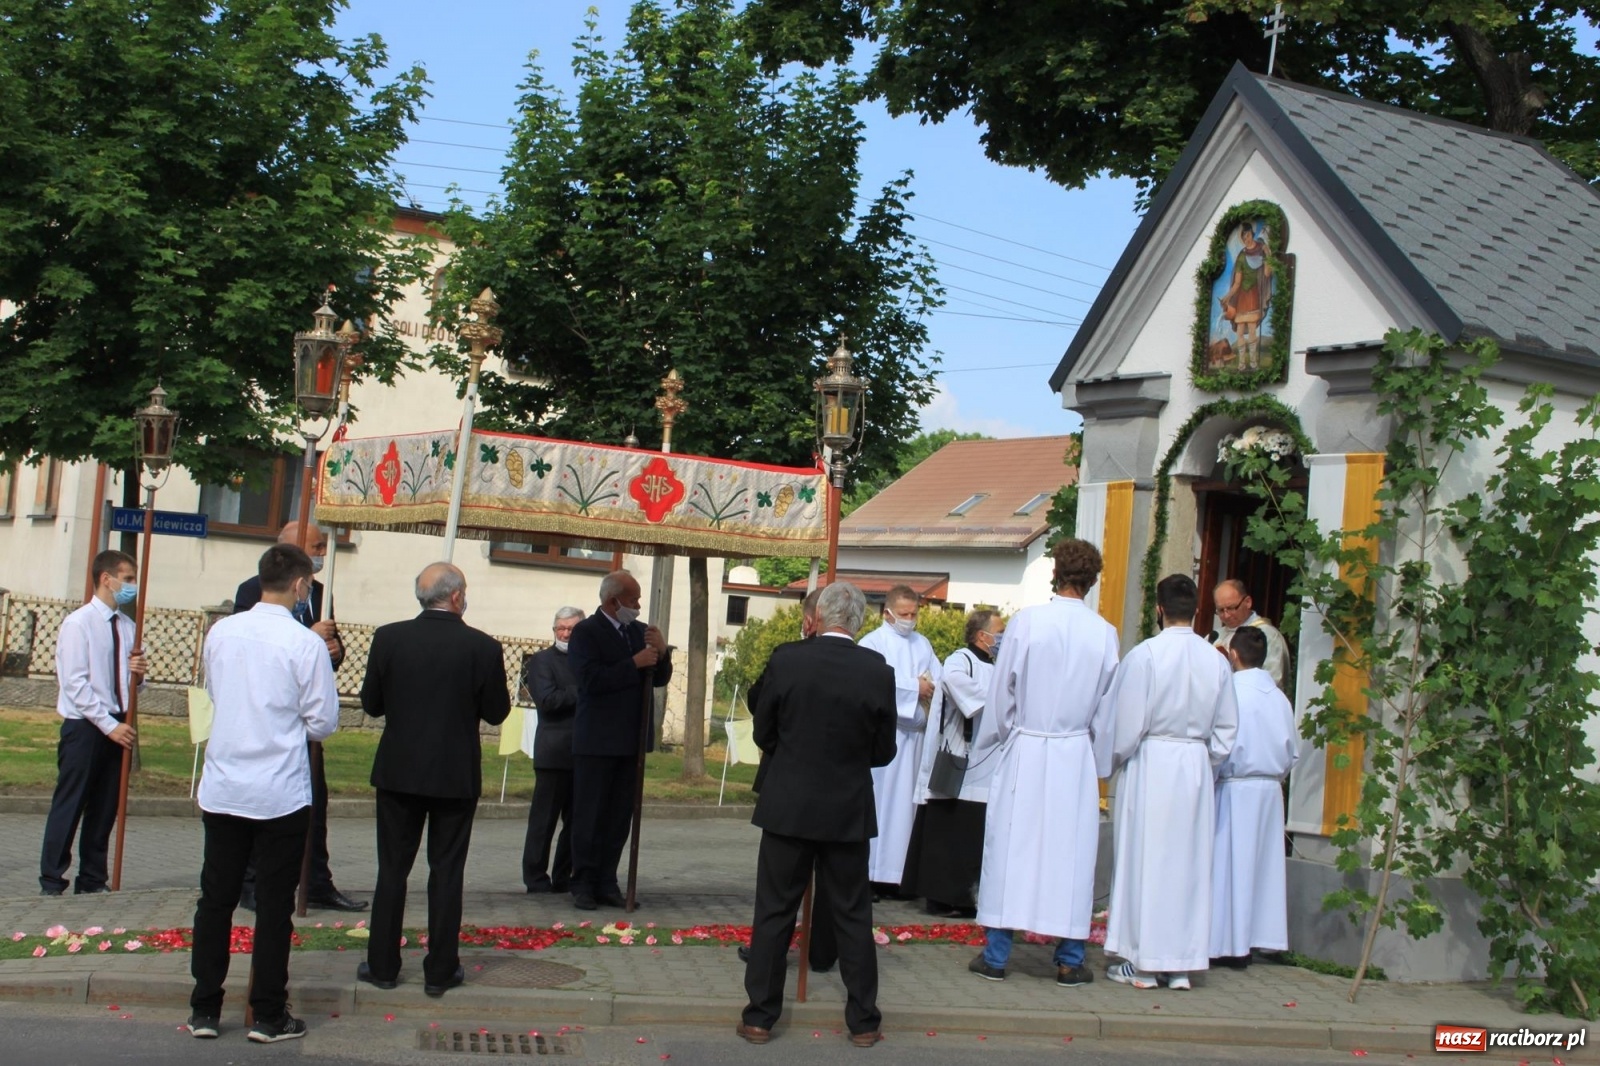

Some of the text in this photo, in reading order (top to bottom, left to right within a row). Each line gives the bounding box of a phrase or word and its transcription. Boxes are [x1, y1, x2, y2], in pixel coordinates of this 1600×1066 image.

[392, 319, 418, 337] SOLI
[422, 324, 445, 342] DEO
[116, 514, 203, 532] ul.Mkiewicza
